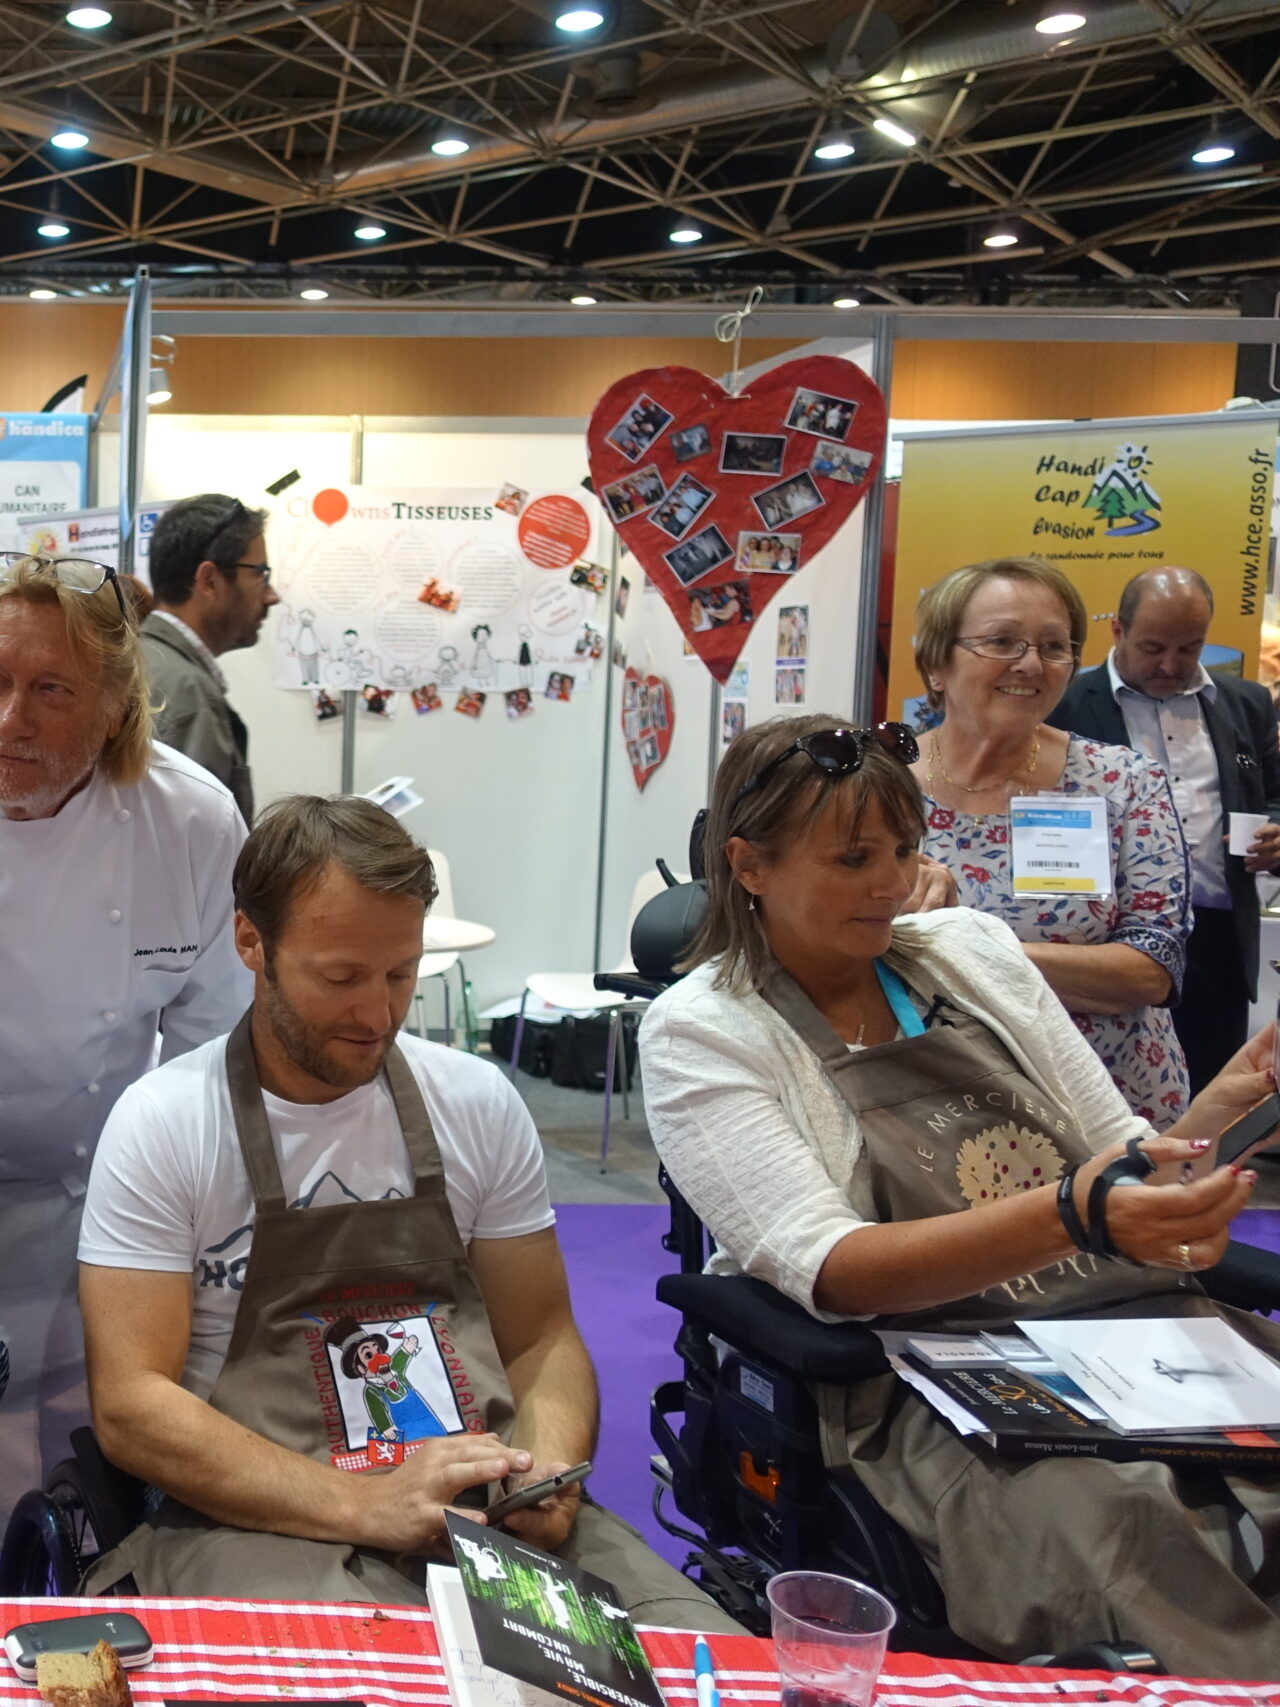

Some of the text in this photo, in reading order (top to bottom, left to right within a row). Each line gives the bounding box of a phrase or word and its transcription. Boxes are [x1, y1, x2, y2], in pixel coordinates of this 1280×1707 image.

[1036, 455, 1106, 477] Handi
[14, 485, 41, 497] CAN
[1035, 485, 1080, 507] Cap
[1240, 448, 1274, 617] www.hce.asso.fr
[917, 1146, 935, 1173] LE
[322, 1303, 422, 1323] BOUCHON
[431, 1315, 486, 1433] LYONNAIS
[303, 1326, 346, 1455] AUTHENTIQUE
[1024, 1441, 1099, 1454] Jean-Louis Manoa
[502, 1618, 572, 1655] UN COMBAT
